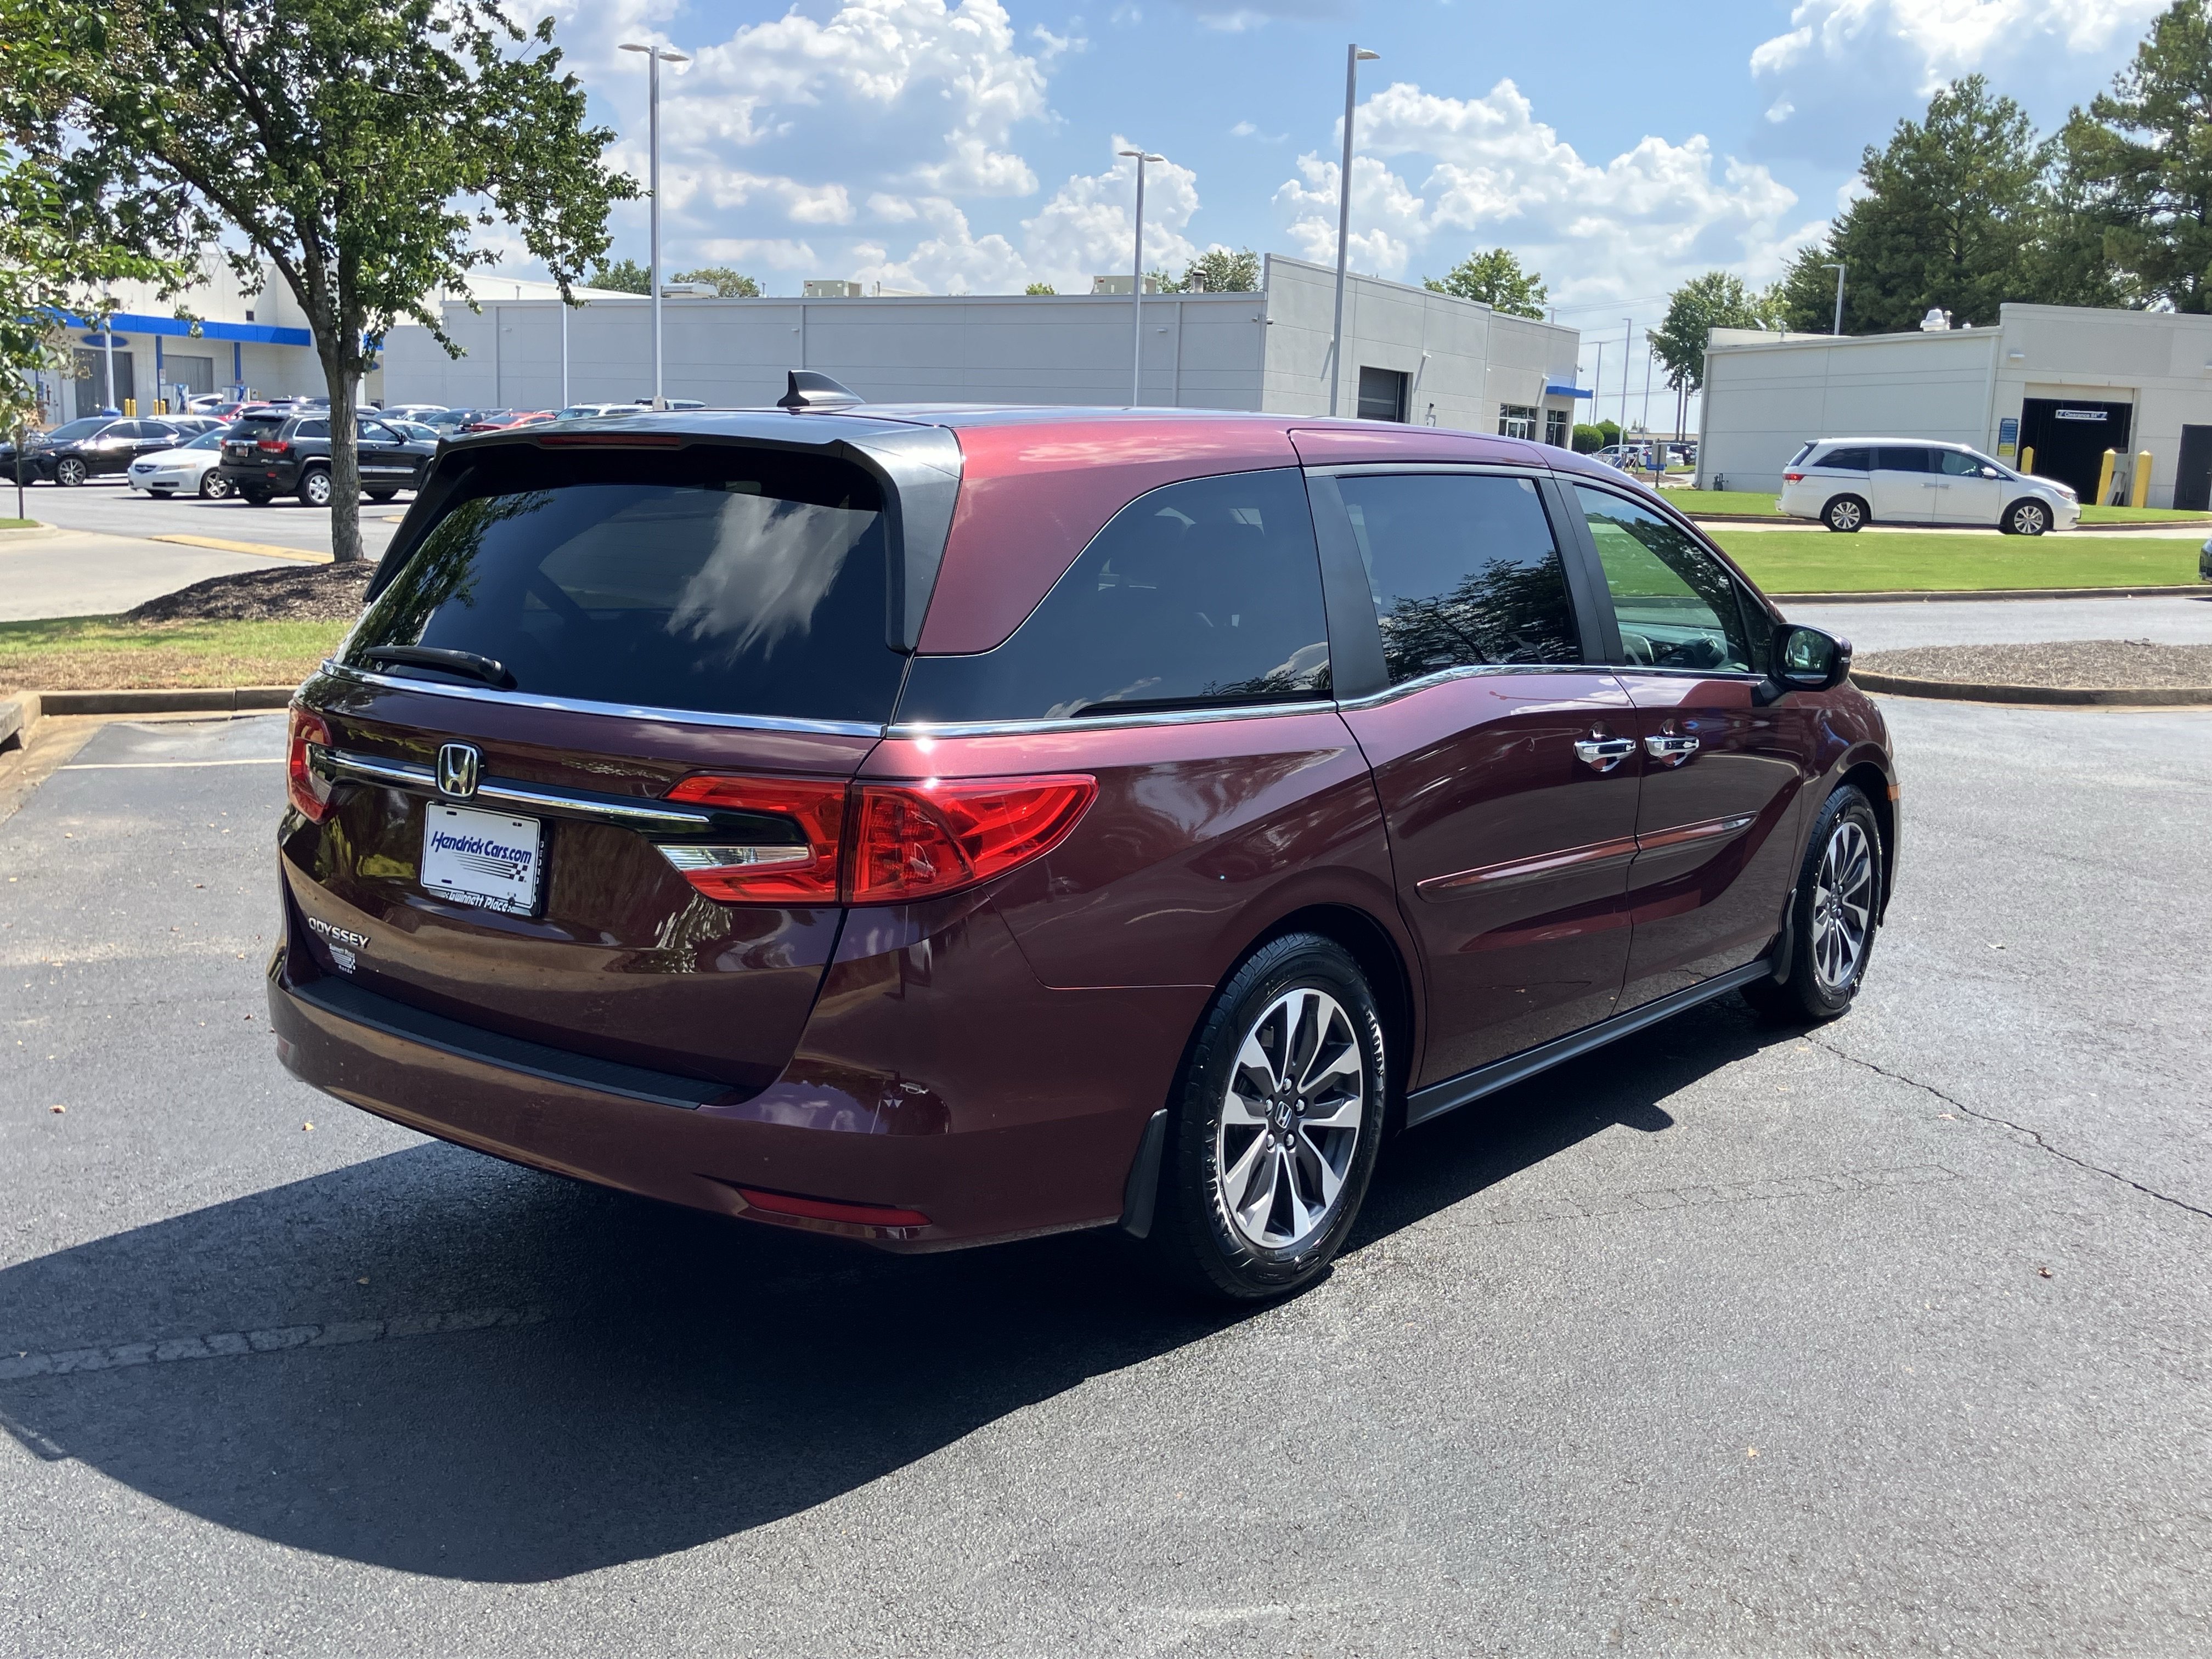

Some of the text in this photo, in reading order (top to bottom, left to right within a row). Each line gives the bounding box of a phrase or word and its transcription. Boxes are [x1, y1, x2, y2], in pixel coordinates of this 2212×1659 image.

[448, 891, 509, 912] Gwinnett Place
[308, 917, 369, 949] ODYSSEY
